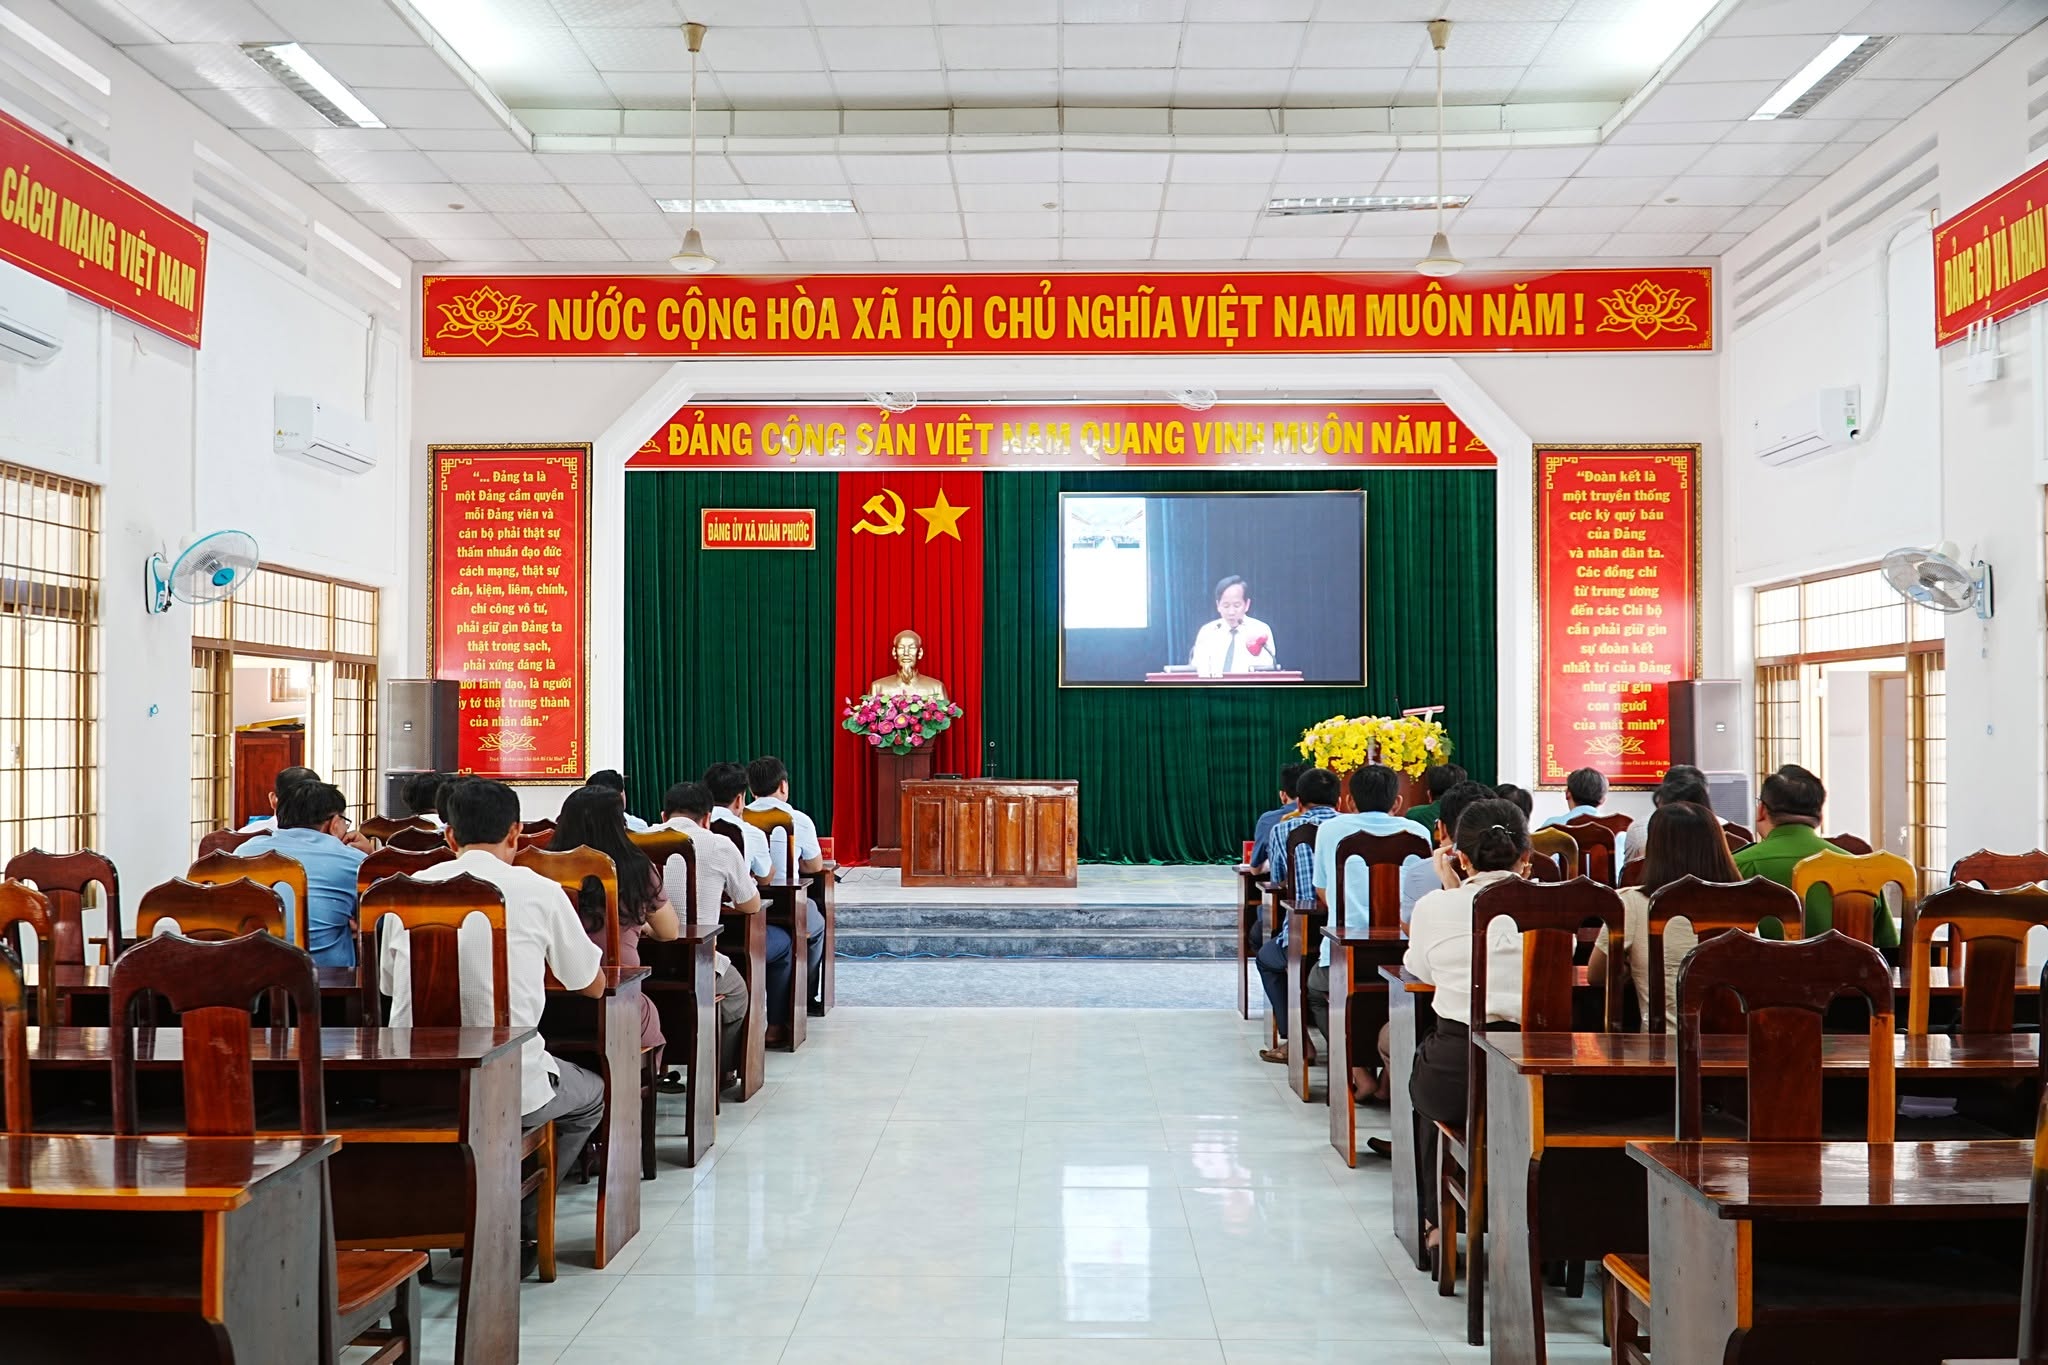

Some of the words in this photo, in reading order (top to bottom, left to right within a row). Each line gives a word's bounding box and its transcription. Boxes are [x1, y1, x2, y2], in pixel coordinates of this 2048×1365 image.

[1, 165, 57, 241] CÁCH
[58, 198, 115, 270] MẠNG
[121, 229, 157, 296] VIỆT
[158, 252, 195, 312] NAM
[1944, 236, 1974, 316] ĐẢNG
[1976, 225, 1992, 309] BỘ
[1993, 216, 2010, 291] VÀ
[2010, 200, 2046, 283] NHÂN
[549, 286, 646, 340] NƯỚC
[658, 286, 756, 350] CỘNG
[767, 285, 840, 339] HÒA
[852, 287, 901, 339] XÃ
[913, 285, 972, 350] HỘI
[984, 280, 1055, 339] CHỦ
[1067, 285, 1176, 338] NGHĨA
[1182, 284, 1262, 347] VIỆT
[1275, 294, 1355, 337] NAM
[1366, 280, 1473, 336] MUÔN
[1481, 281, 1565, 336] NĂM
[1575, 293, 1584, 335] !
[667, 409, 752, 455] ĐẢNG
[761, 415, 847, 463] CỘNG
[855, 409, 920, 458] SẢN
[925, 414, 995, 464] VIỆT
[1001, 422, 1073, 455] NAM
[1081, 421, 1184, 461] QUANG
[1193, 422, 1265, 455] VINH
[1273, 413, 1363, 455] MUÔN
[1372, 415, 1441, 454] NĂM
[1448, 422, 1456, 453] !
[493, 470, 519, 484] Đảng
[523, 472, 533, 482] ta
[537, 471, 546, 481] là
[1620, 470, 1641, 482] kết
[1645, 471, 1656, 481] là
[456, 491, 475, 503] một
[479, 490, 505, 502] Đảng
[509, 489, 530, 500] cầm
[534, 488, 564, 502] quyền
[1563, 491, 1587, 503] một
[1590, 489, 1630, 502] truyền
[1635, 489, 1670, 503] thống
[465, 507, 484, 519] mỗi
[487, 508, 514, 521] Đảng
[518, 509, 538, 519] viên
[542, 509, 553, 519] và
[1569, 510, 1592, 522] cực
[1596, 509, 1610, 522] kỳ
[1614, 509, 1635, 522] quý
[1641, 509, 1663, 520] báu
[459, 528, 477, 538] cán
[481, 528, 494, 540] bộ
[498, 527, 520, 540] phải
[523, 527, 544, 540] thật
[708, 517, 730, 541] ĐẢNG
[745, 520, 756, 541] XÃ
[758, 520, 781, 541] XUÂN
[782, 520, 810, 542] PHƯỚC
[1587, 527, 1610, 539] của
[1614, 527, 1646, 541] Đảng
[457, 546, 483, 557] thấm
[487, 545, 518, 557] nhuần
[522, 547, 540, 559] đạo
[543, 546, 561, 556] đức
[1569, 547, 1583, 558] và
[1588, 547, 1618, 558] nhân
[1621, 547, 1644, 558] dân
[1648, 548, 1664, 558] ta.
[460, 565, 484, 576] cách
[488, 566, 519, 578] mạng,
[522, 565, 543, 578] thật
[1577, 566, 1600, 577] Các
[1604, 565, 1634, 579] đồng
[1638, 566, 1657, 577] chí
[451, 583, 473, 596] cần,
[477, 584, 504, 597] kiệm,
[508, 584, 533, 596] liêm,
[537, 583, 567, 596] chính,
[1592, 586, 1625, 598] trung
[1629, 586, 1659, 598] ương
[471, 603, 486, 614] chí
[490, 603, 514, 615] công
[518, 604, 530, 613] vô
[534, 603, 547, 614] tư,
[1571, 603, 1593, 615] đến
[1597, 604, 1619, 616] các
[1622, 604, 1642, 615] Chi
[1647, 604, 1662, 618] bộ
[457, 621, 479, 634] phải
[522, 620, 548, 634] Đảng
[552, 622, 562, 632] ta
[1567, 622, 1589, 634] cần
[1594, 623, 1620, 637] phải
[468, 641, 489, 653] thật
[492, 641, 520, 653] trong
[524, 640, 551, 653] sạch,
[1632, 642, 1653, 653] kết
[463, 659, 485, 672] phải
[489, 659, 514, 672] xứng
[518, 659, 542, 671] đáng
[546, 659, 555, 669] là
[1594, 662, 1609, 673] trí
[1613, 661, 1635, 673] của
[1639, 661, 1671, 675] Đảng
[479, 677, 501, 689] lãnh
[505, 678, 526, 691] đạo,
[530, 678, 539, 688] là
[543, 678, 571, 690] người
[470, 697, 481, 708] tớ
[484, 697, 506, 710] thật
[509, 698, 537, 709] trung
[540, 697, 569, 707] thành
[1587, 703, 1609, 711] con
[470, 715, 488, 727] của
[492, 716, 516, 727] nhân
[1573, 718, 1596, 730] của
